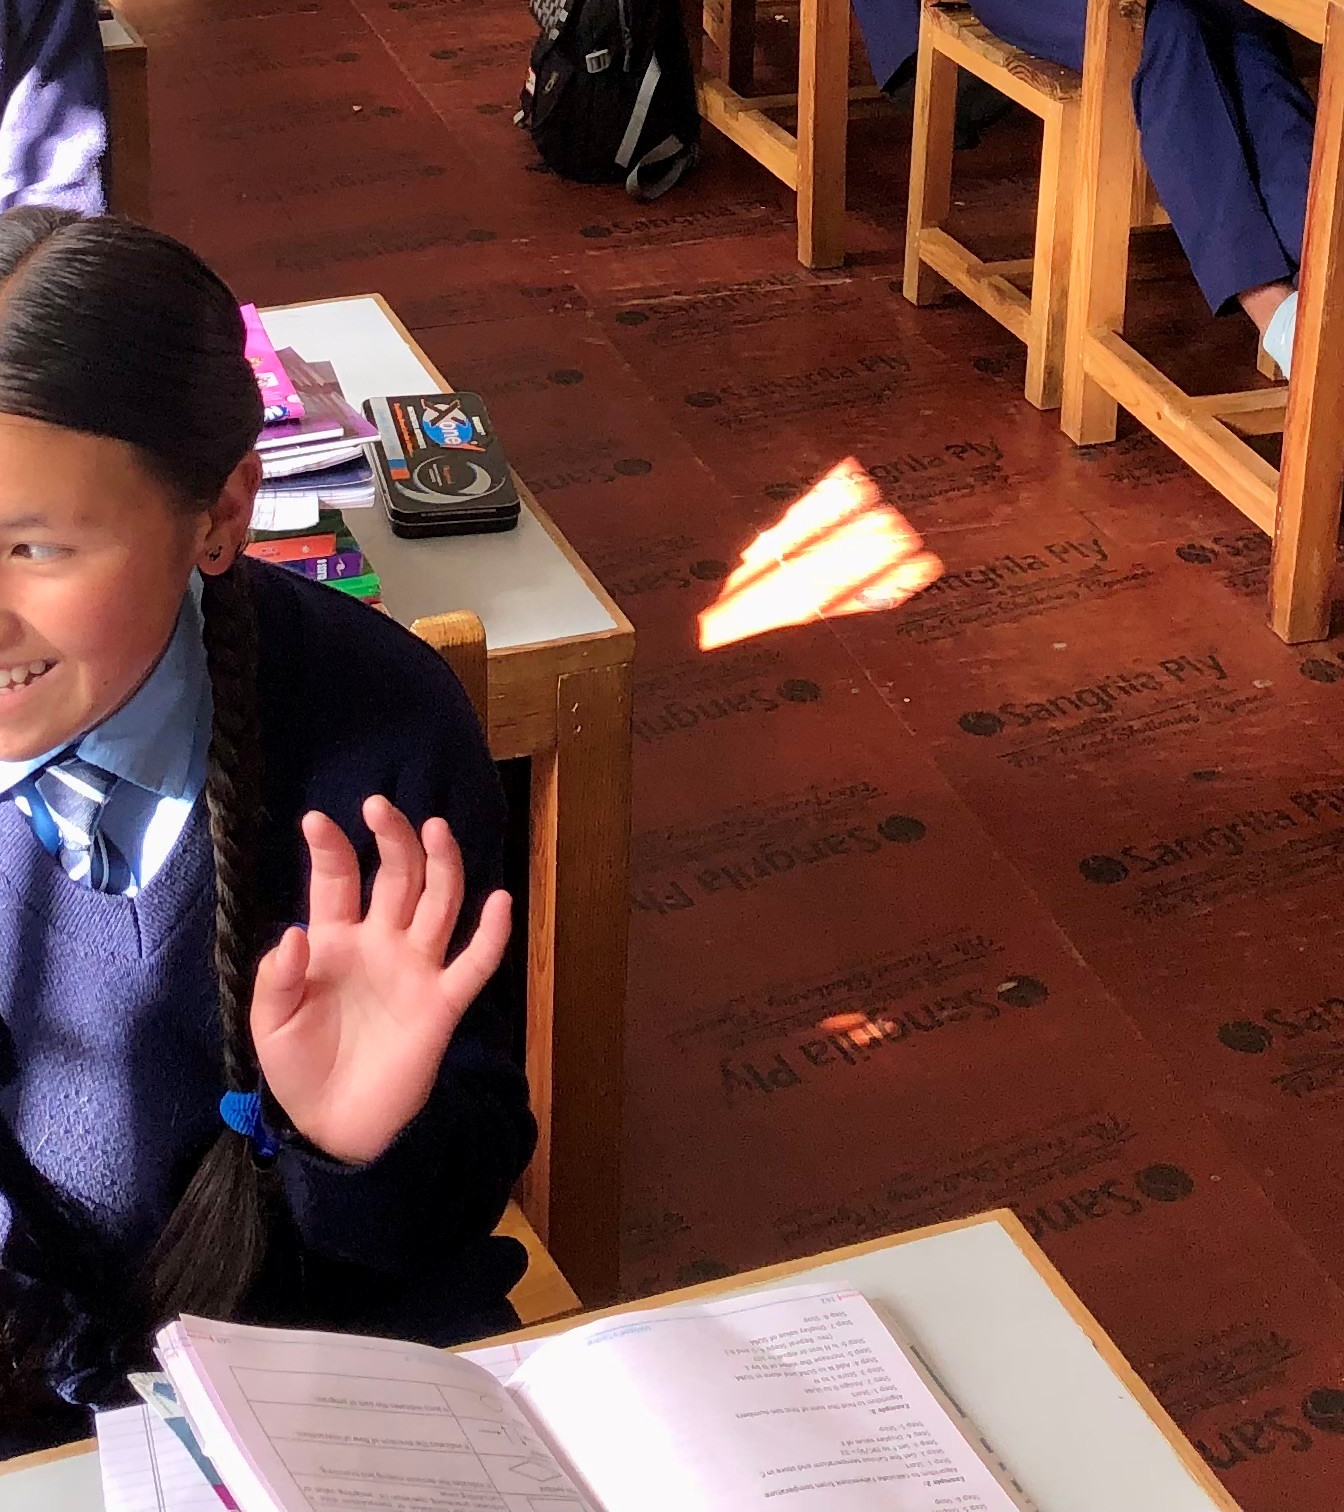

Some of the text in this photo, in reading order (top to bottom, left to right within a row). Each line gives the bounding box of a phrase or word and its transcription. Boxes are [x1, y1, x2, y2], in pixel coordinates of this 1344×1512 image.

[439, 421, 463, 445] one
[1044, 536, 1110, 573] Ply
[1000, 652, 1229, 726] Sangrila Ply
[1119, 806, 1299, 871] Sangrila
[719, 1052, 803, 1094] Ply
